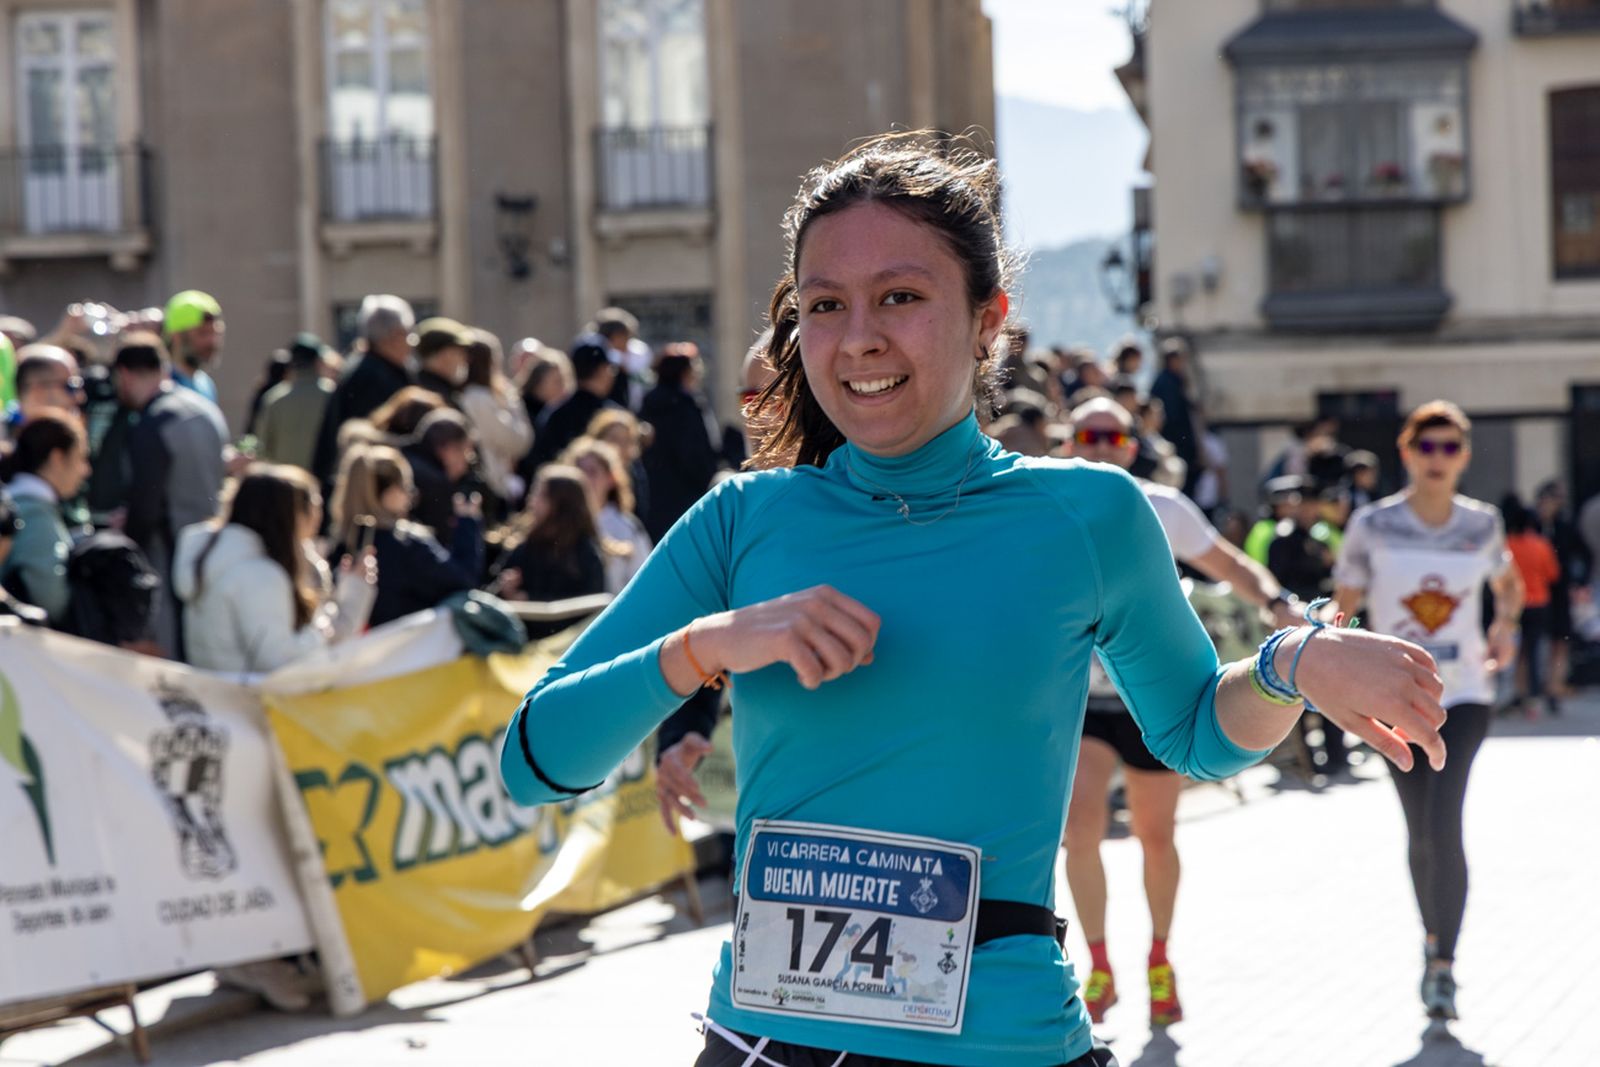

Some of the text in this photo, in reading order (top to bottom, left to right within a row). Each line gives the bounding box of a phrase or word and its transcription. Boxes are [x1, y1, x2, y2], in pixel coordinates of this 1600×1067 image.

[767, 840, 943, 876] VI CARRERA CAMINATA
[763, 866, 902, 907] BUENA MUERTE
[786, 907, 894, 979] 174
[778, 973, 811, 986] SUSANA
[851, 981, 897, 996] PORTILLA
